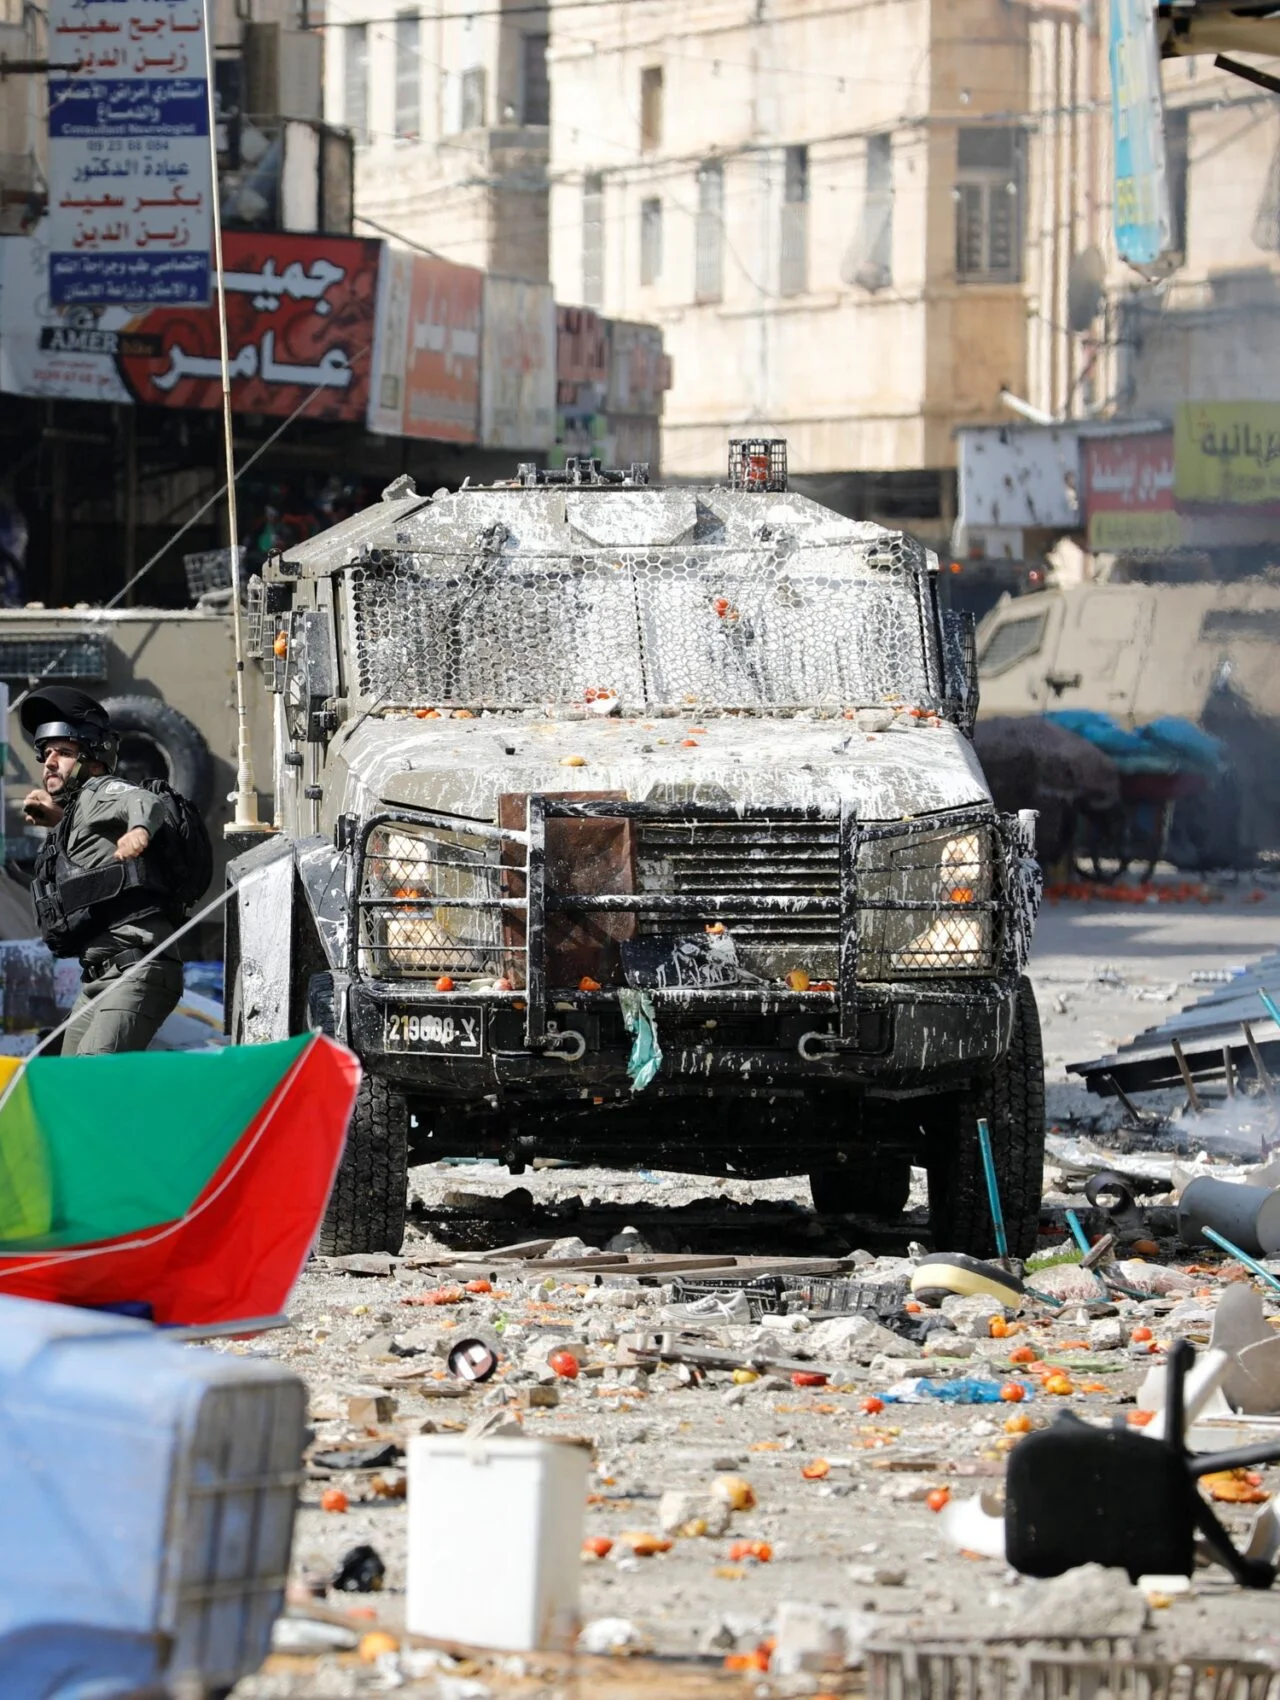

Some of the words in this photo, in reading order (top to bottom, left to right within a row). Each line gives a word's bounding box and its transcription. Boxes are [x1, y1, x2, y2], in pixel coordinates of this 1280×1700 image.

[55, 17, 121, 40] سعيد
[71, 46, 127, 75] الدين
[133, 42, 188, 74] زين
[61, 123, 126, 136] Consultant
[127, 123, 196, 136] Neurologist
[72, 156, 138, 183] الدكتور
[143, 156, 190, 182] عيادة
[58, 191, 125, 214] سعيد
[131, 184, 203, 214] بكر
[72, 220, 130, 248] الدين
[135, 217, 191, 248] زين
[213, 256, 346, 316] جمي
[50, 330, 118, 355] AMER
[152, 329, 353, 391] عامر
